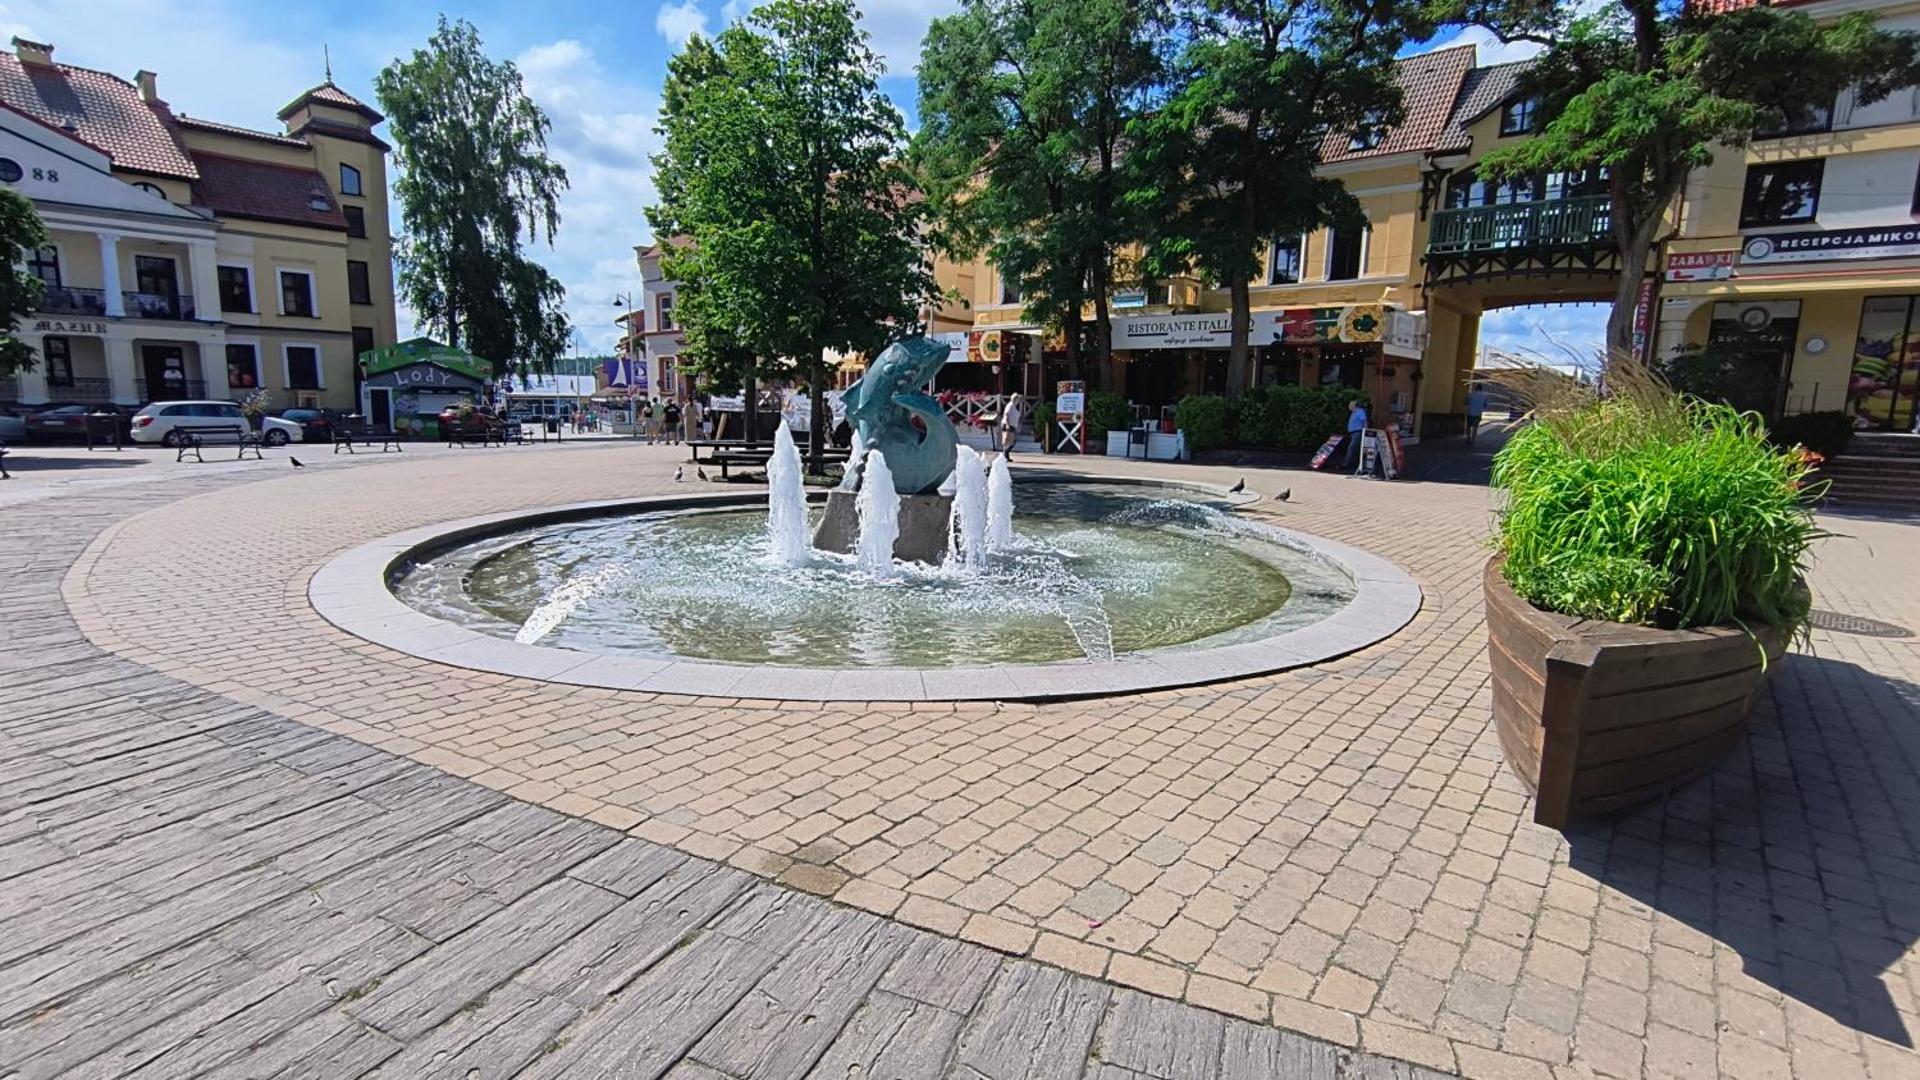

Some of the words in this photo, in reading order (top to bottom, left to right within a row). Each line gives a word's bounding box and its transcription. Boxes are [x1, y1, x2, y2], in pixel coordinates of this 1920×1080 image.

[32, 167, 59, 183] 88
[1780, 234, 1864, 248] RECEPCJA
[1670, 253, 1731, 266] ZABAWKI
[1128, 321, 1196, 334] RISTORANTE
[1198, 318, 1255, 331] ITALIO
